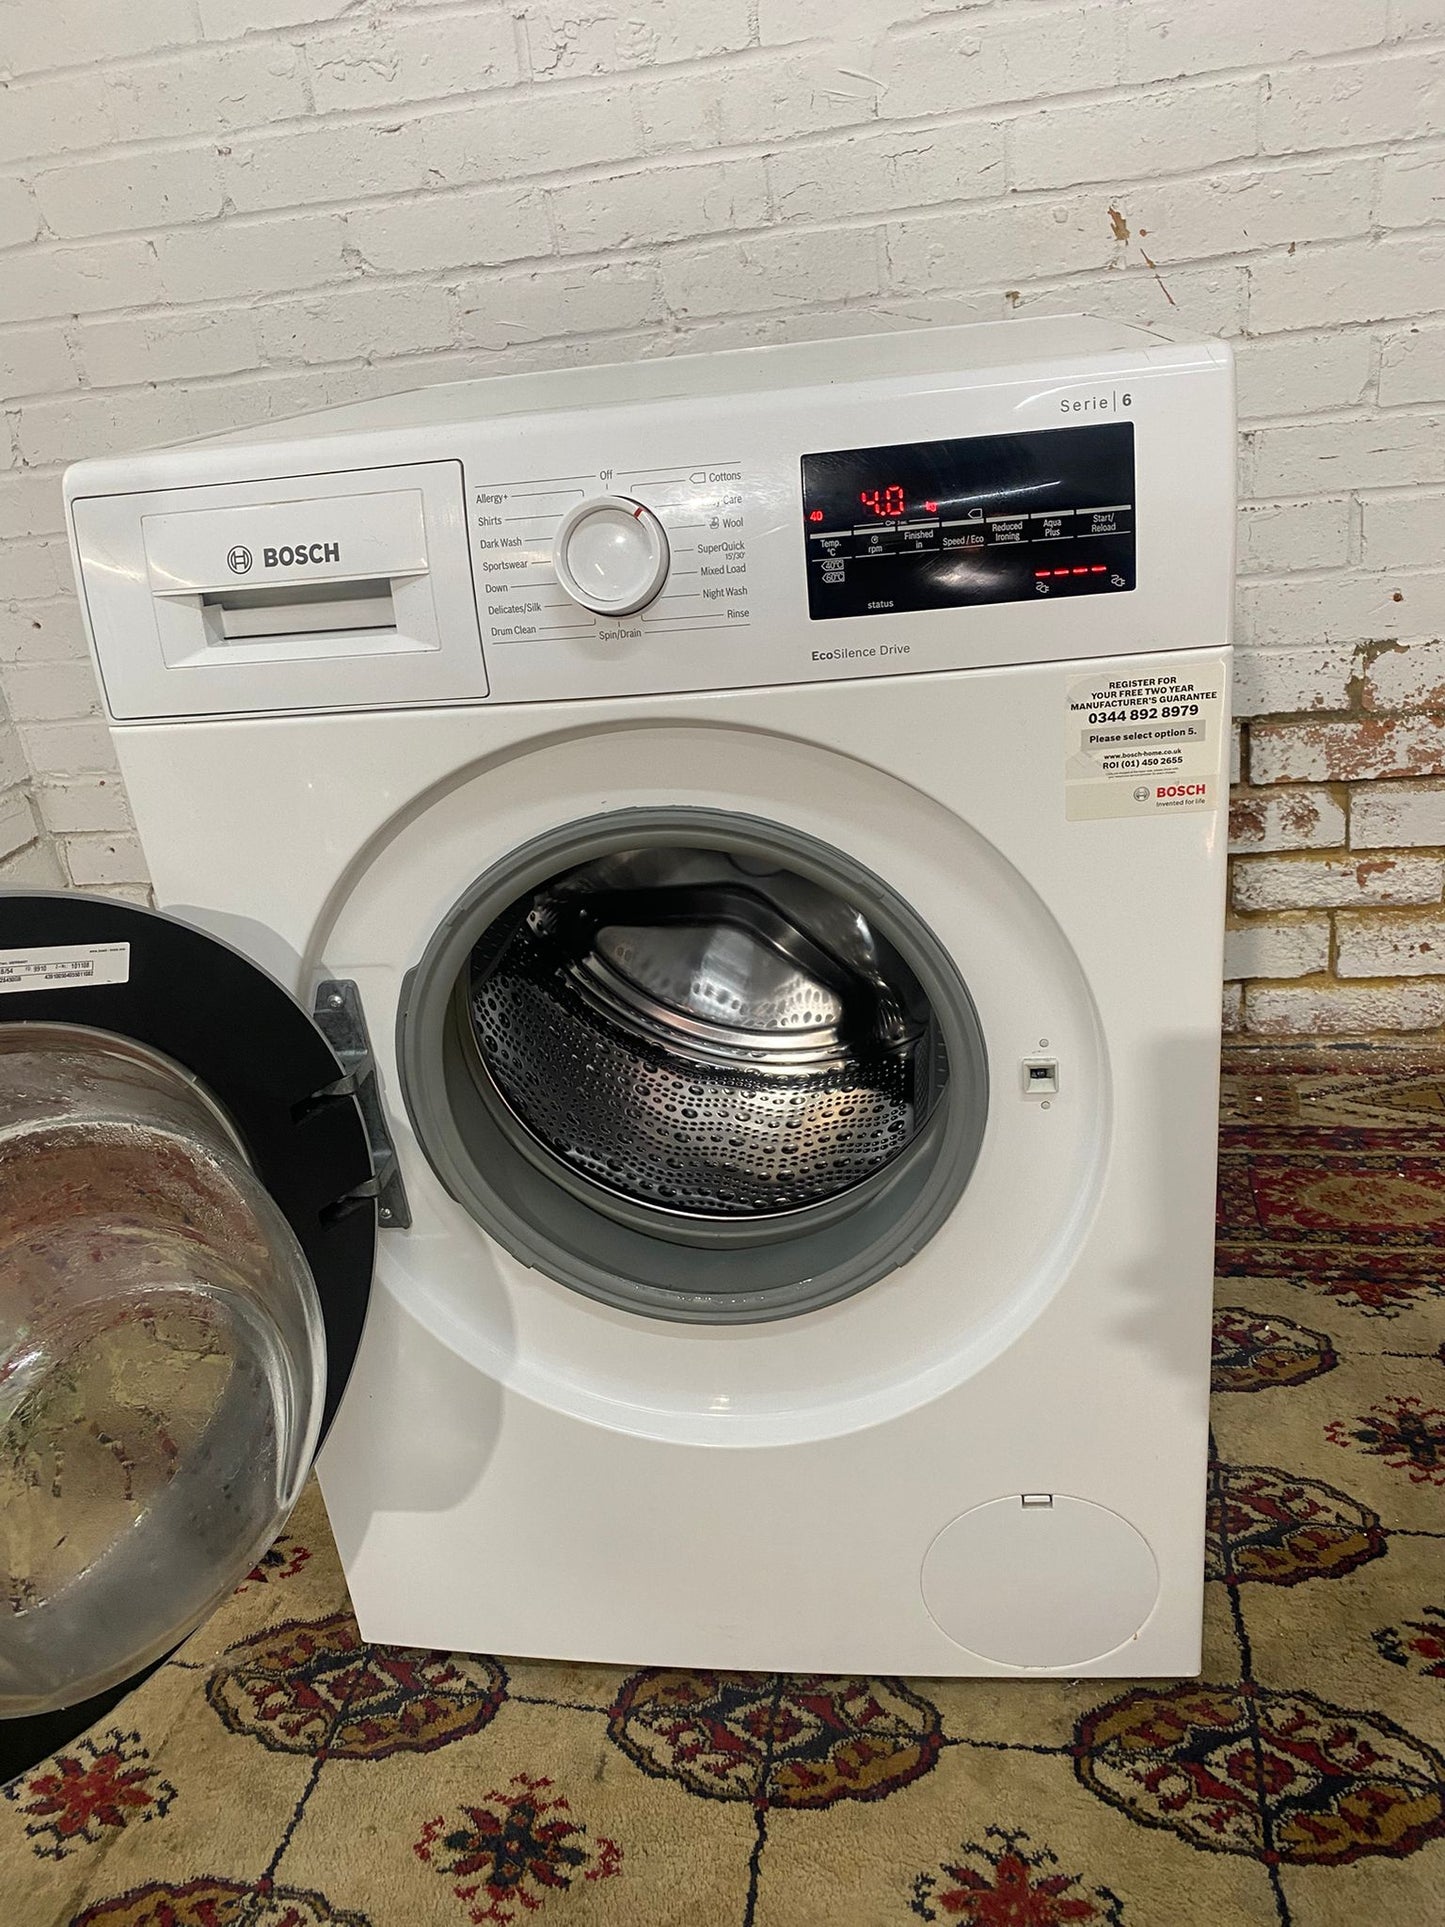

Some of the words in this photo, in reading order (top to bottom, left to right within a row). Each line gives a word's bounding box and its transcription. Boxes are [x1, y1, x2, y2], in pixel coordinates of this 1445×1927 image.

[1060, 397, 1108, 412] Serie
[1122, 393, 1132, 406] 6
[600, 470, 613, 480] Off
[709, 472, 742, 483] Cottons
[476, 493, 508, 504] Allergy+
[723, 495, 743, 505] Care
[478, 516, 502, 527] Shirts
[809, 511, 823, 522] 40
[1093, 513, 1114, 524] Start/
[722, 517, 744, 528] Wool
[992, 521, 1023, 532] Reduced
[1043, 519, 1062, 529] Aqua
[1091, 522, 1116, 532] Reload
[904, 530, 934, 541] Finished
[995, 532, 1020, 542] Ironing
[1045, 527, 1061, 537] Plus
[480, 539, 499, 549] Dark
[500, 537, 522, 547] Wash
[821, 539, 842, 548] Temp.
[915, 540, 923, 549] in
[943, 535, 965, 547] Speed
[970, 535, 984, 544] Eco
[697, 541, 745, 554] SuperQuick
[868, 545, 883, 554] rpm
[263, 542, 340, 567] BOSCH
[483, 560, 528, 572] Sportswear
[700, 565, 725, 576] Mixed
[726, 563, 746, 574] Load
[485, 583, 508, 594] Down
[703, 588, 724, 600] Night
[725, 586, 748, 597] Wash
[488, 603, 542, 615] Delicates/Silk
[867, 600, 894, 610] status
[727, 608, 749, 618] Rinse
[491, 627, 513, 637] Drum
[514, 625, 536, 635] Clean
[599, 629, 642, 641] Spin/Drain
[812, 648, 876, 661] EcoSilence
[880, 644, 910, 656] Drive
[1109, 678, 1155, 689] REGISTER
[1157, 677, 1177, 686] FOR
[1092, 691, 1117, 700] YOUR
[1119, 689, 1143, 698] FREE
[1145, 686, 1167, 695] TWO
[1168, 684, 1194, 693] YEAR
[1070, 697, 1157, 711] MANUFACTURER'S
[1159, 691, 1217, 704] GUARANTEE
[1088, 710, 1126, 724] 0344
[1130, 708, 1158, 721] 892
[1161, 704, 1199, 718] 8979
[1089, 733, 1121, 743] Please
[1123, 731, 1152, 741] select
[1154, 728, 1186, 740] option
[1188, 727, 1197, 735] 5.
[1104, 748, 1182, 760] www.bosch-home.co.uk
[1102, 761, 1119, 770] ROI
[1121, 759, 1140, 769] (01)
[1142, 757, 1159, 766] 450
[1160, 756, 1183, 765] 2655
[1157, 784, 1206, 798] BOSCH
